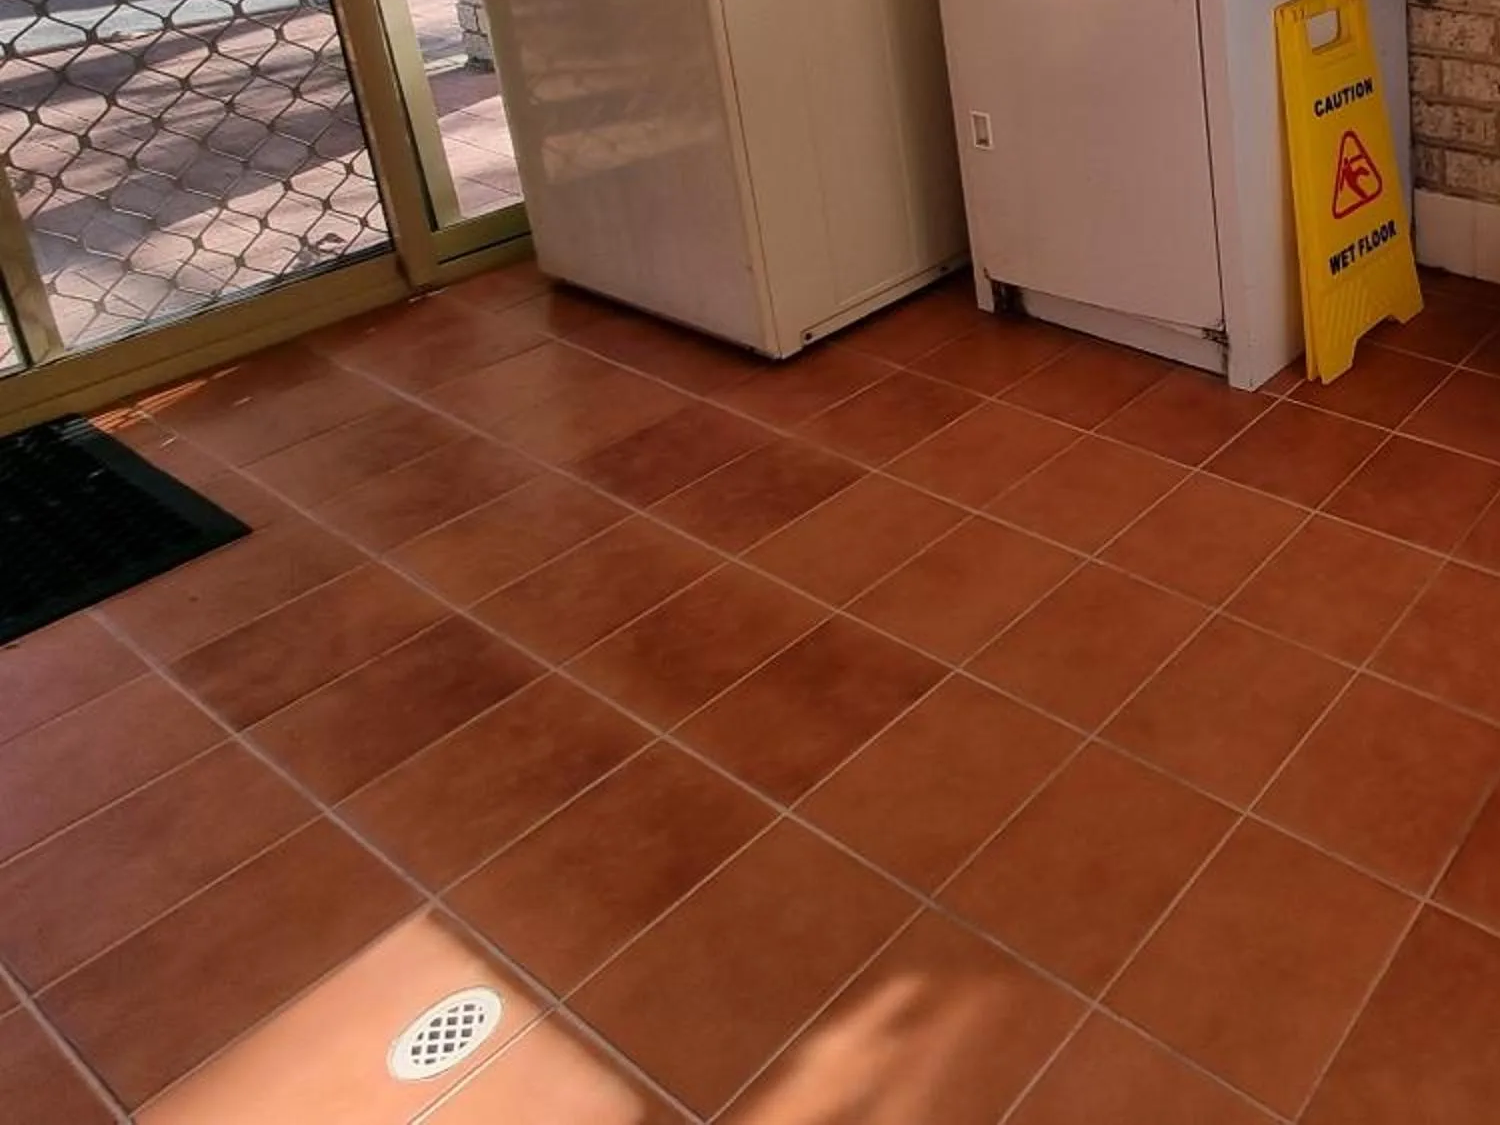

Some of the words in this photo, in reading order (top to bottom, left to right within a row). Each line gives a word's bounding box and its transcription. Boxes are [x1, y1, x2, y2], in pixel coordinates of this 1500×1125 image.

[1313, 76, 1374, 118] CAUTION
[1329, 243, 1355, 277] WET
[1358, 219, 1397, 258] FLOOR
